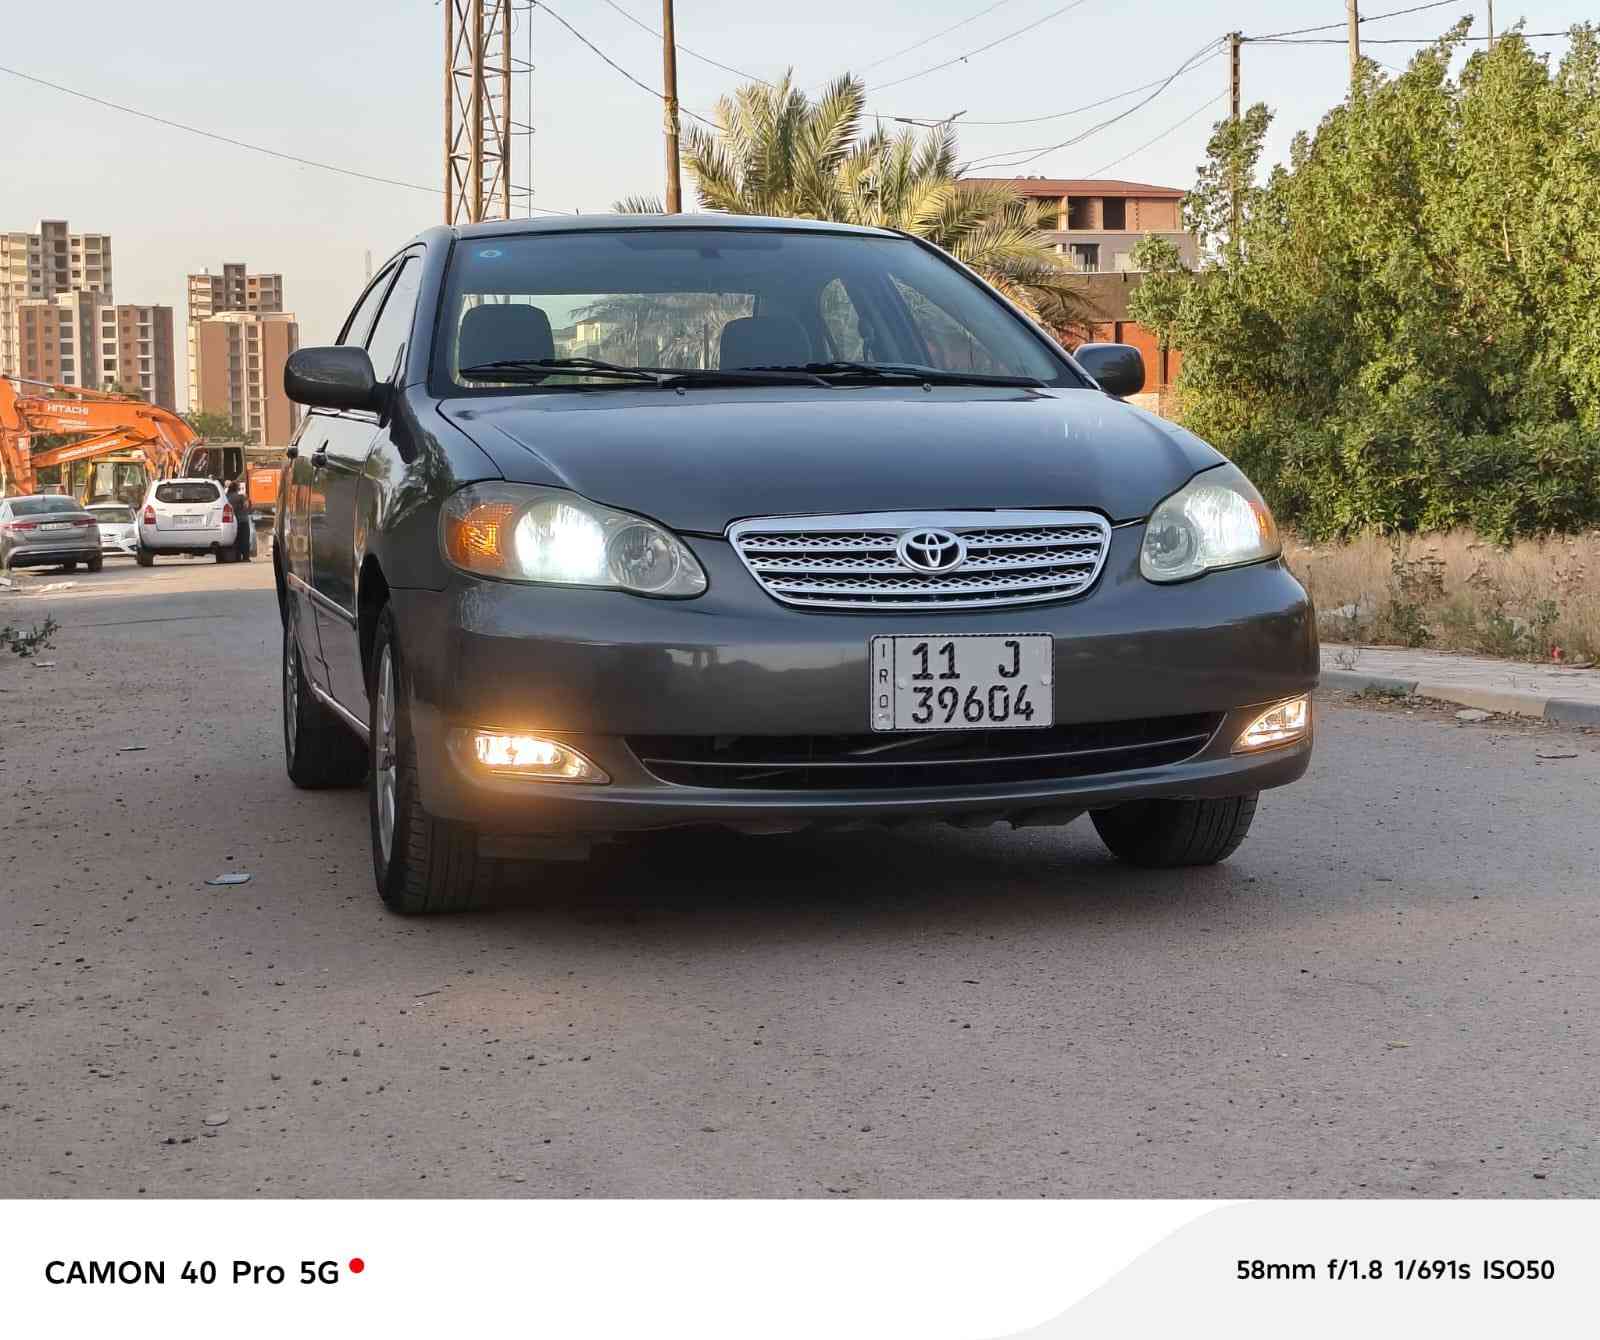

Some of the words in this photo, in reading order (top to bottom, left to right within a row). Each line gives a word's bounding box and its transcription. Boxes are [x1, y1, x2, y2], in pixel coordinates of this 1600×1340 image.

[47, 404, 89, 415] HITACHI
[911, 642, 961, 681] 11
[998, 640, 1021, 679] J
[911, 684, 1035, 724] 39604
